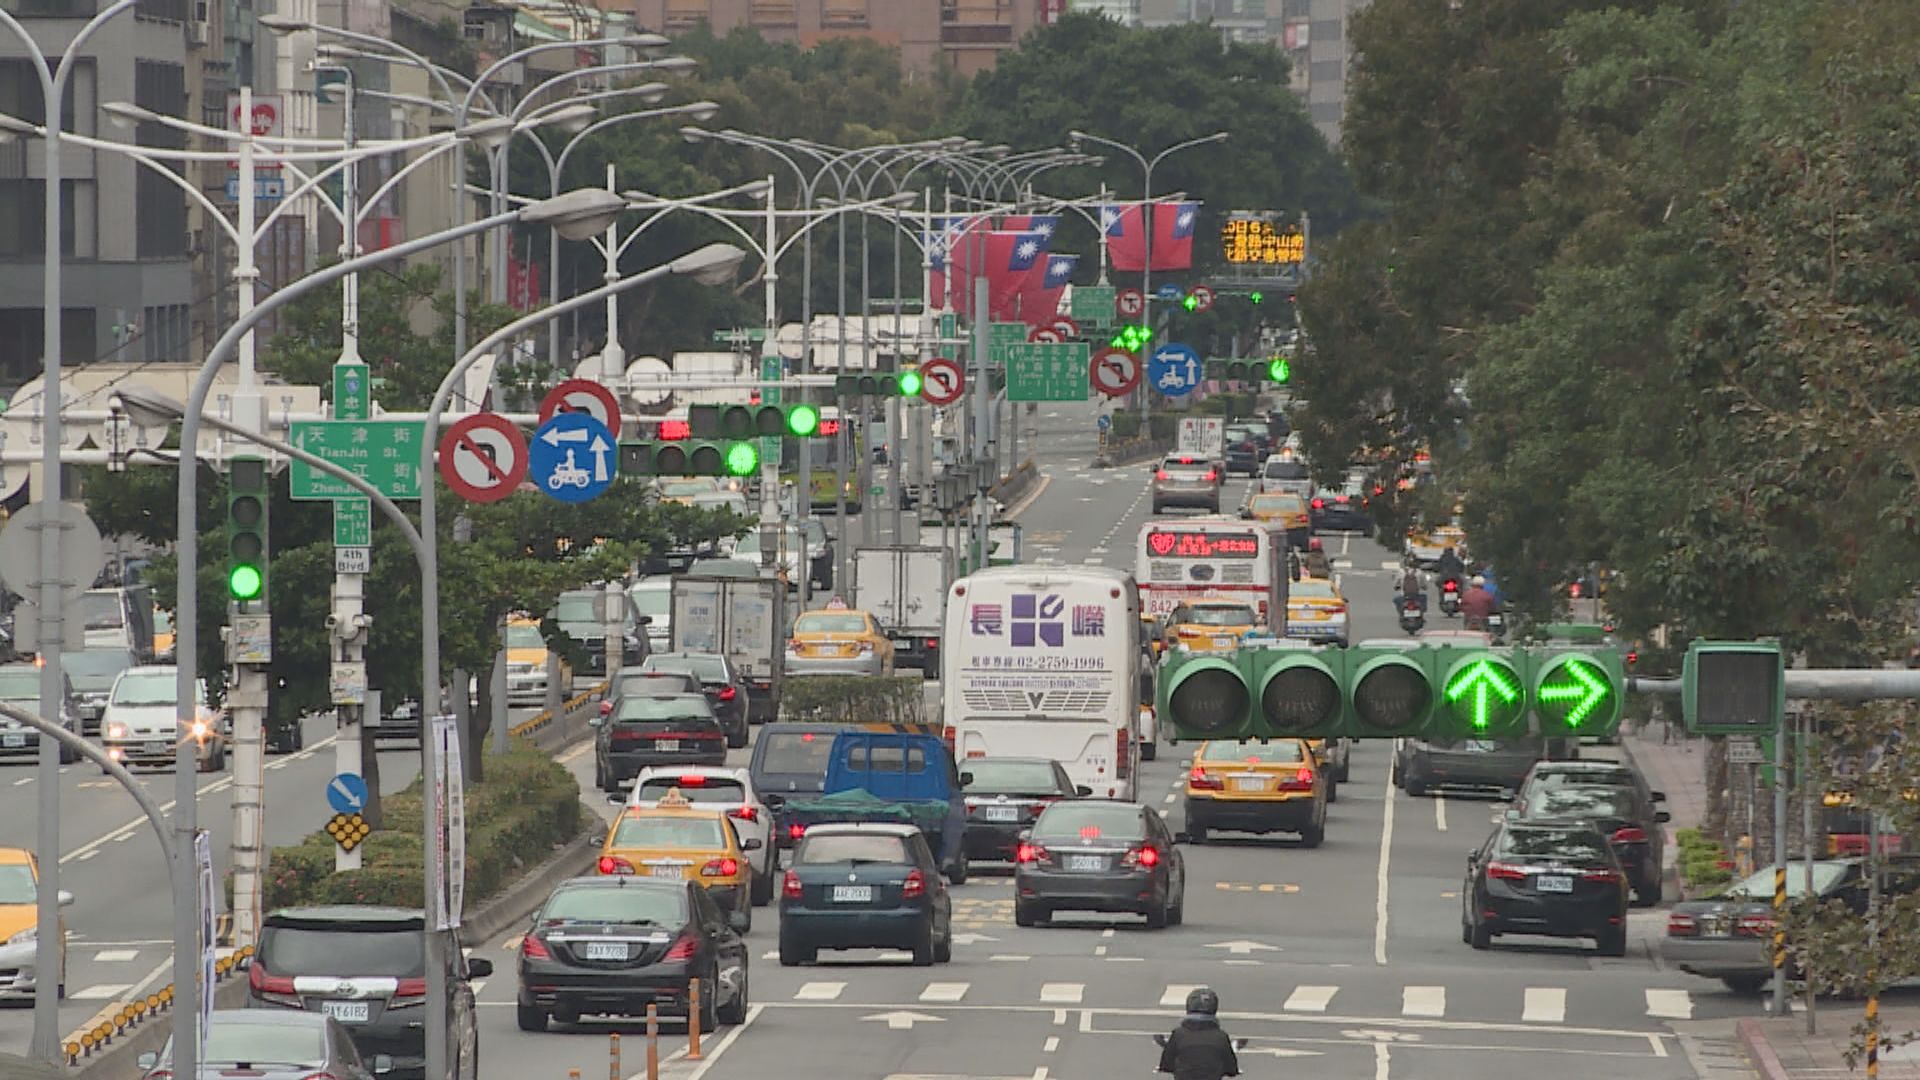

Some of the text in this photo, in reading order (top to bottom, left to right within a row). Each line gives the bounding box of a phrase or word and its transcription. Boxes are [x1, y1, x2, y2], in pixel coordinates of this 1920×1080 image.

[309, 427, 411, 443] 天津街
[319, 446, 401, 457] TianJin St.
[392, 483, 409, 493] St.
[343, 550, 362, 559] 4th
[1150, 600, 1172, 613] 842
[970, 604, 1003, 636] 長
[1017, 656, 1105, 669] 02-2759-1996
